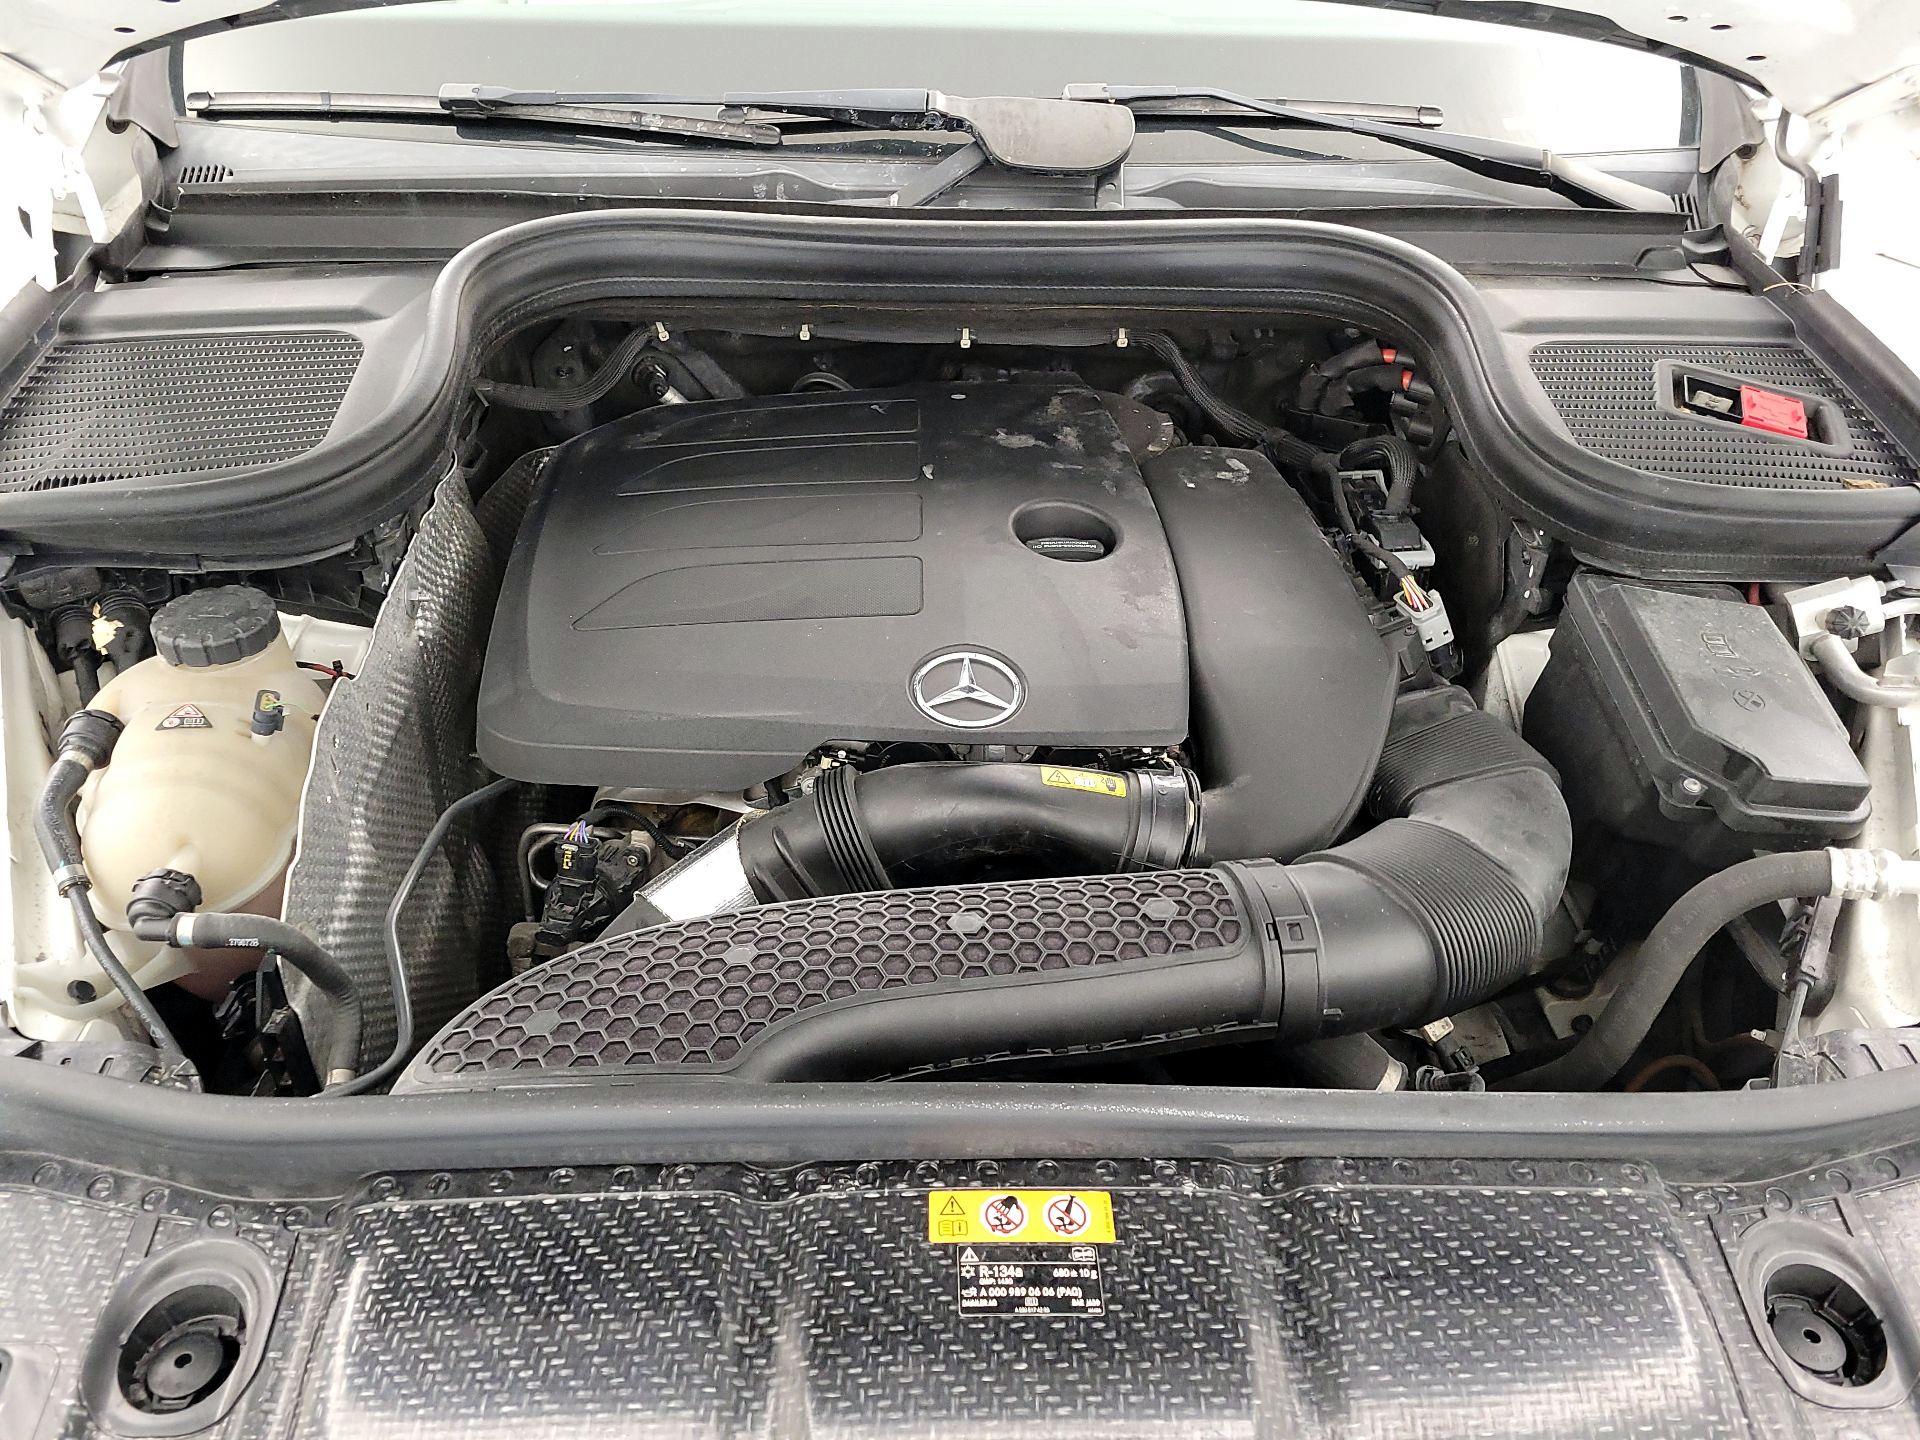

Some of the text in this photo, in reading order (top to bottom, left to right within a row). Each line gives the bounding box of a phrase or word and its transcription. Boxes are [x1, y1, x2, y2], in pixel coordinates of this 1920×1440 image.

[979, 1264, 1024, 1278] R-134a
[1079, 1267, 1090, 1278] 10
[979, 1286, 1083, 1299] A 000 989 06 06 (PAG)
